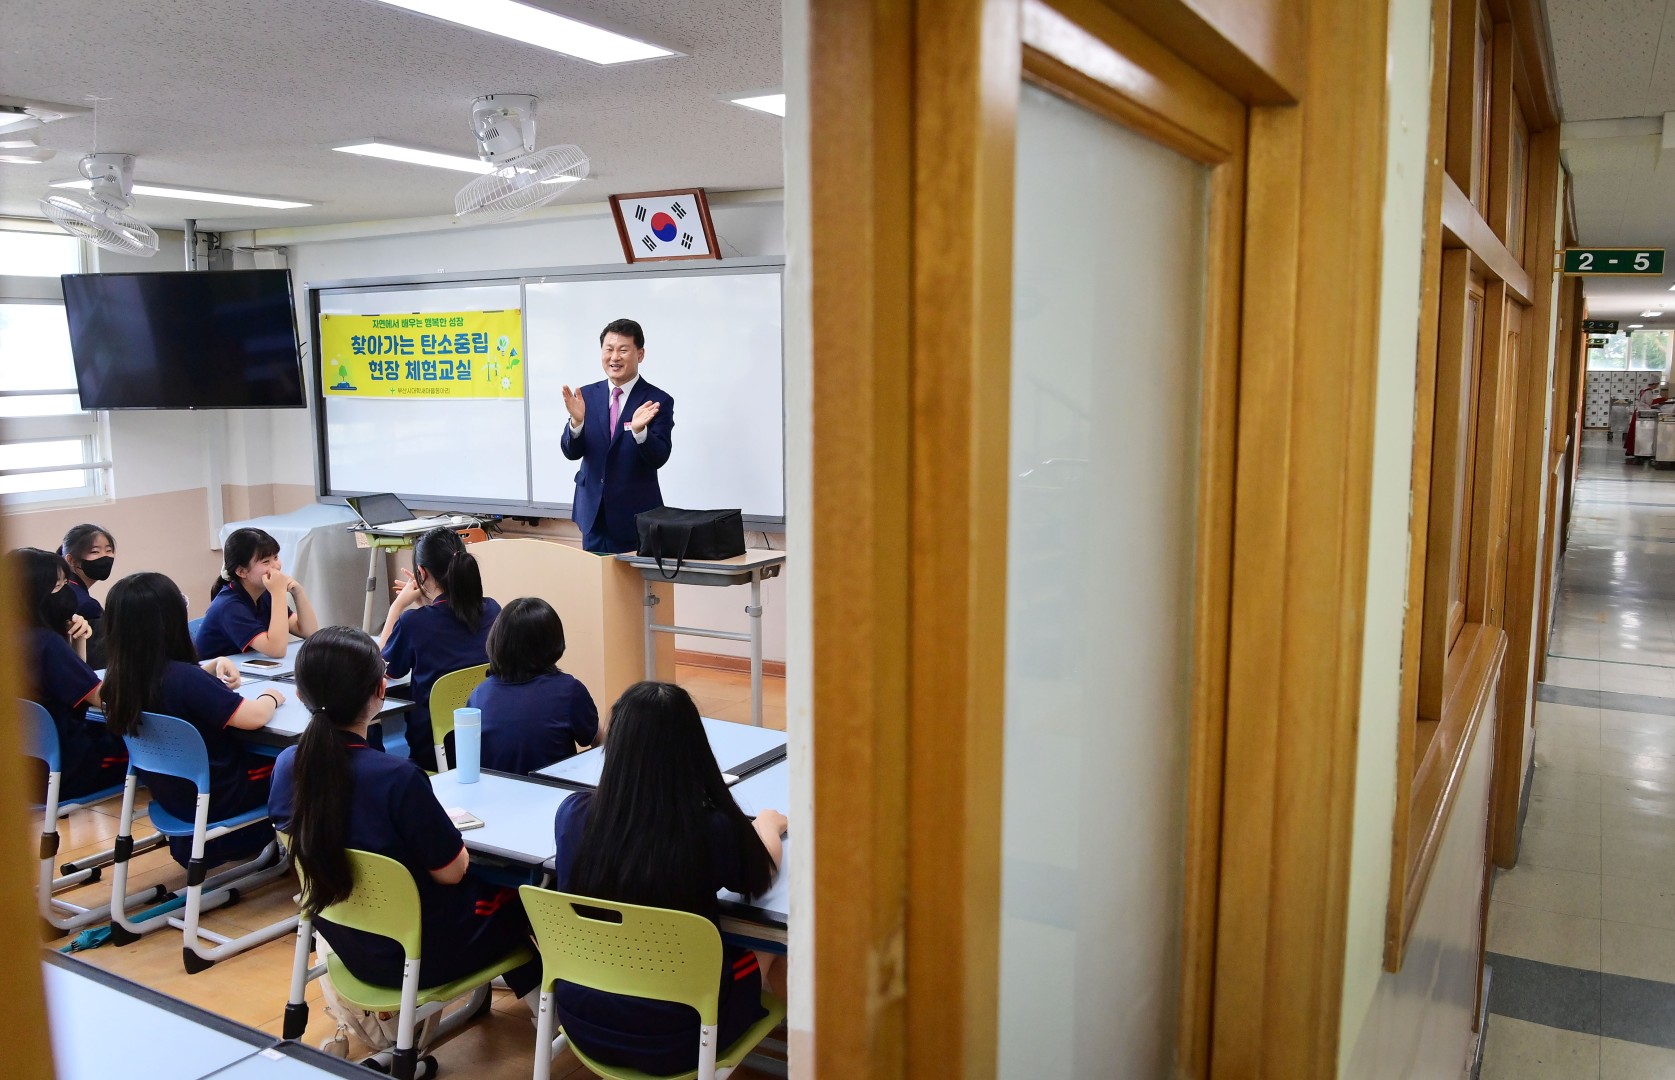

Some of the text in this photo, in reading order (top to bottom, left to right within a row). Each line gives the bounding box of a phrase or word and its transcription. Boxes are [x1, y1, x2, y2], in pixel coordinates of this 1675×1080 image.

[372, 316, 464, 328] 자연에서 배우는 행복한 성장
[351, 332, 489, 355] 찾아가는 탄소중립
[368, 360, 472, 381] 현장 체험교실
